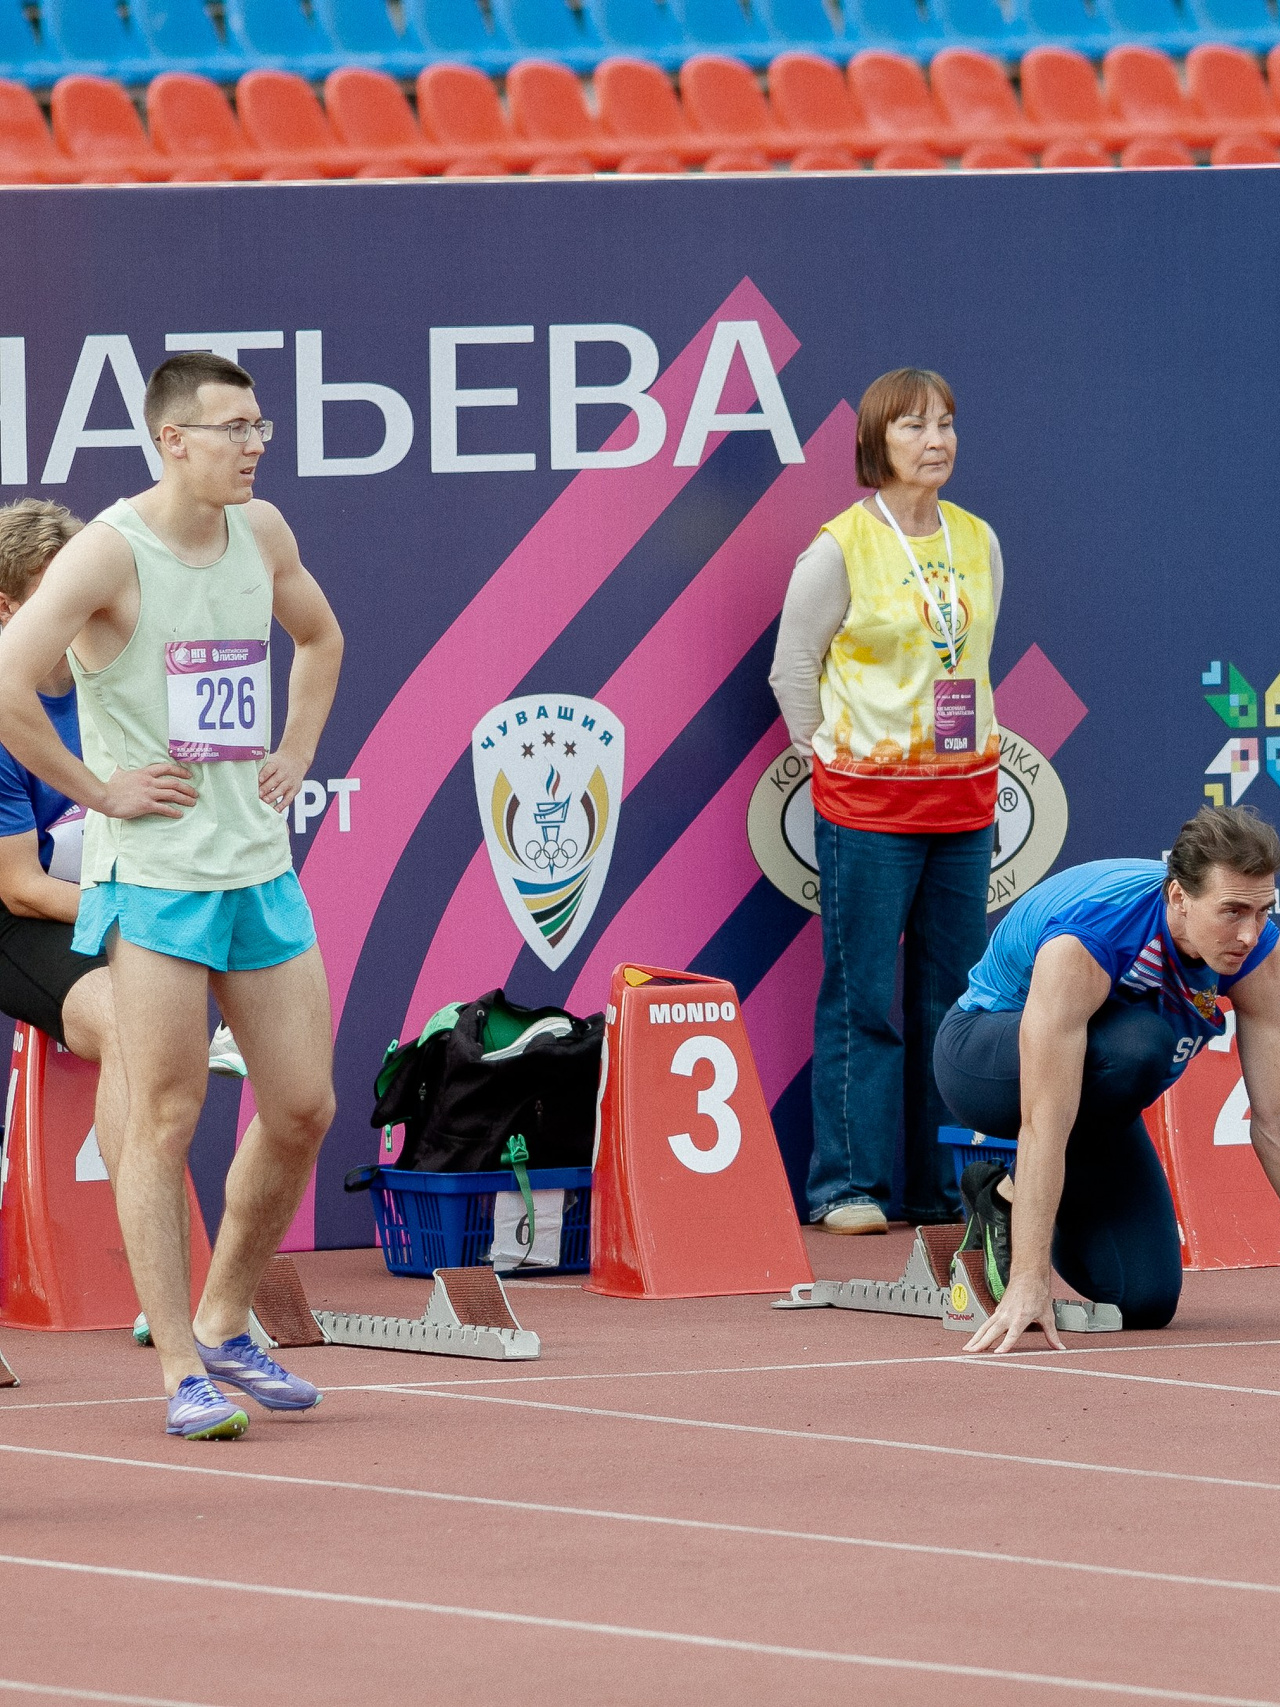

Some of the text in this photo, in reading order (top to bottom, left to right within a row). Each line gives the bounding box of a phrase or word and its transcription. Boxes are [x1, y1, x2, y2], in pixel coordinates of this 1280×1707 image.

[219, 653, 249, 662] ЛИЗИНГ
[196, 676, 256, 730] 226
[480, 705, 614, 751] ЧУВАШИЯ
[944, 737, 968, 750] СУДЬЯ
[999, 733, 1040, 785] ИКА
[284, 778, 361, 834] РТ
[649, 1001, 736, 1025] MONDO
[667, 1035, 742, 1174] 3
